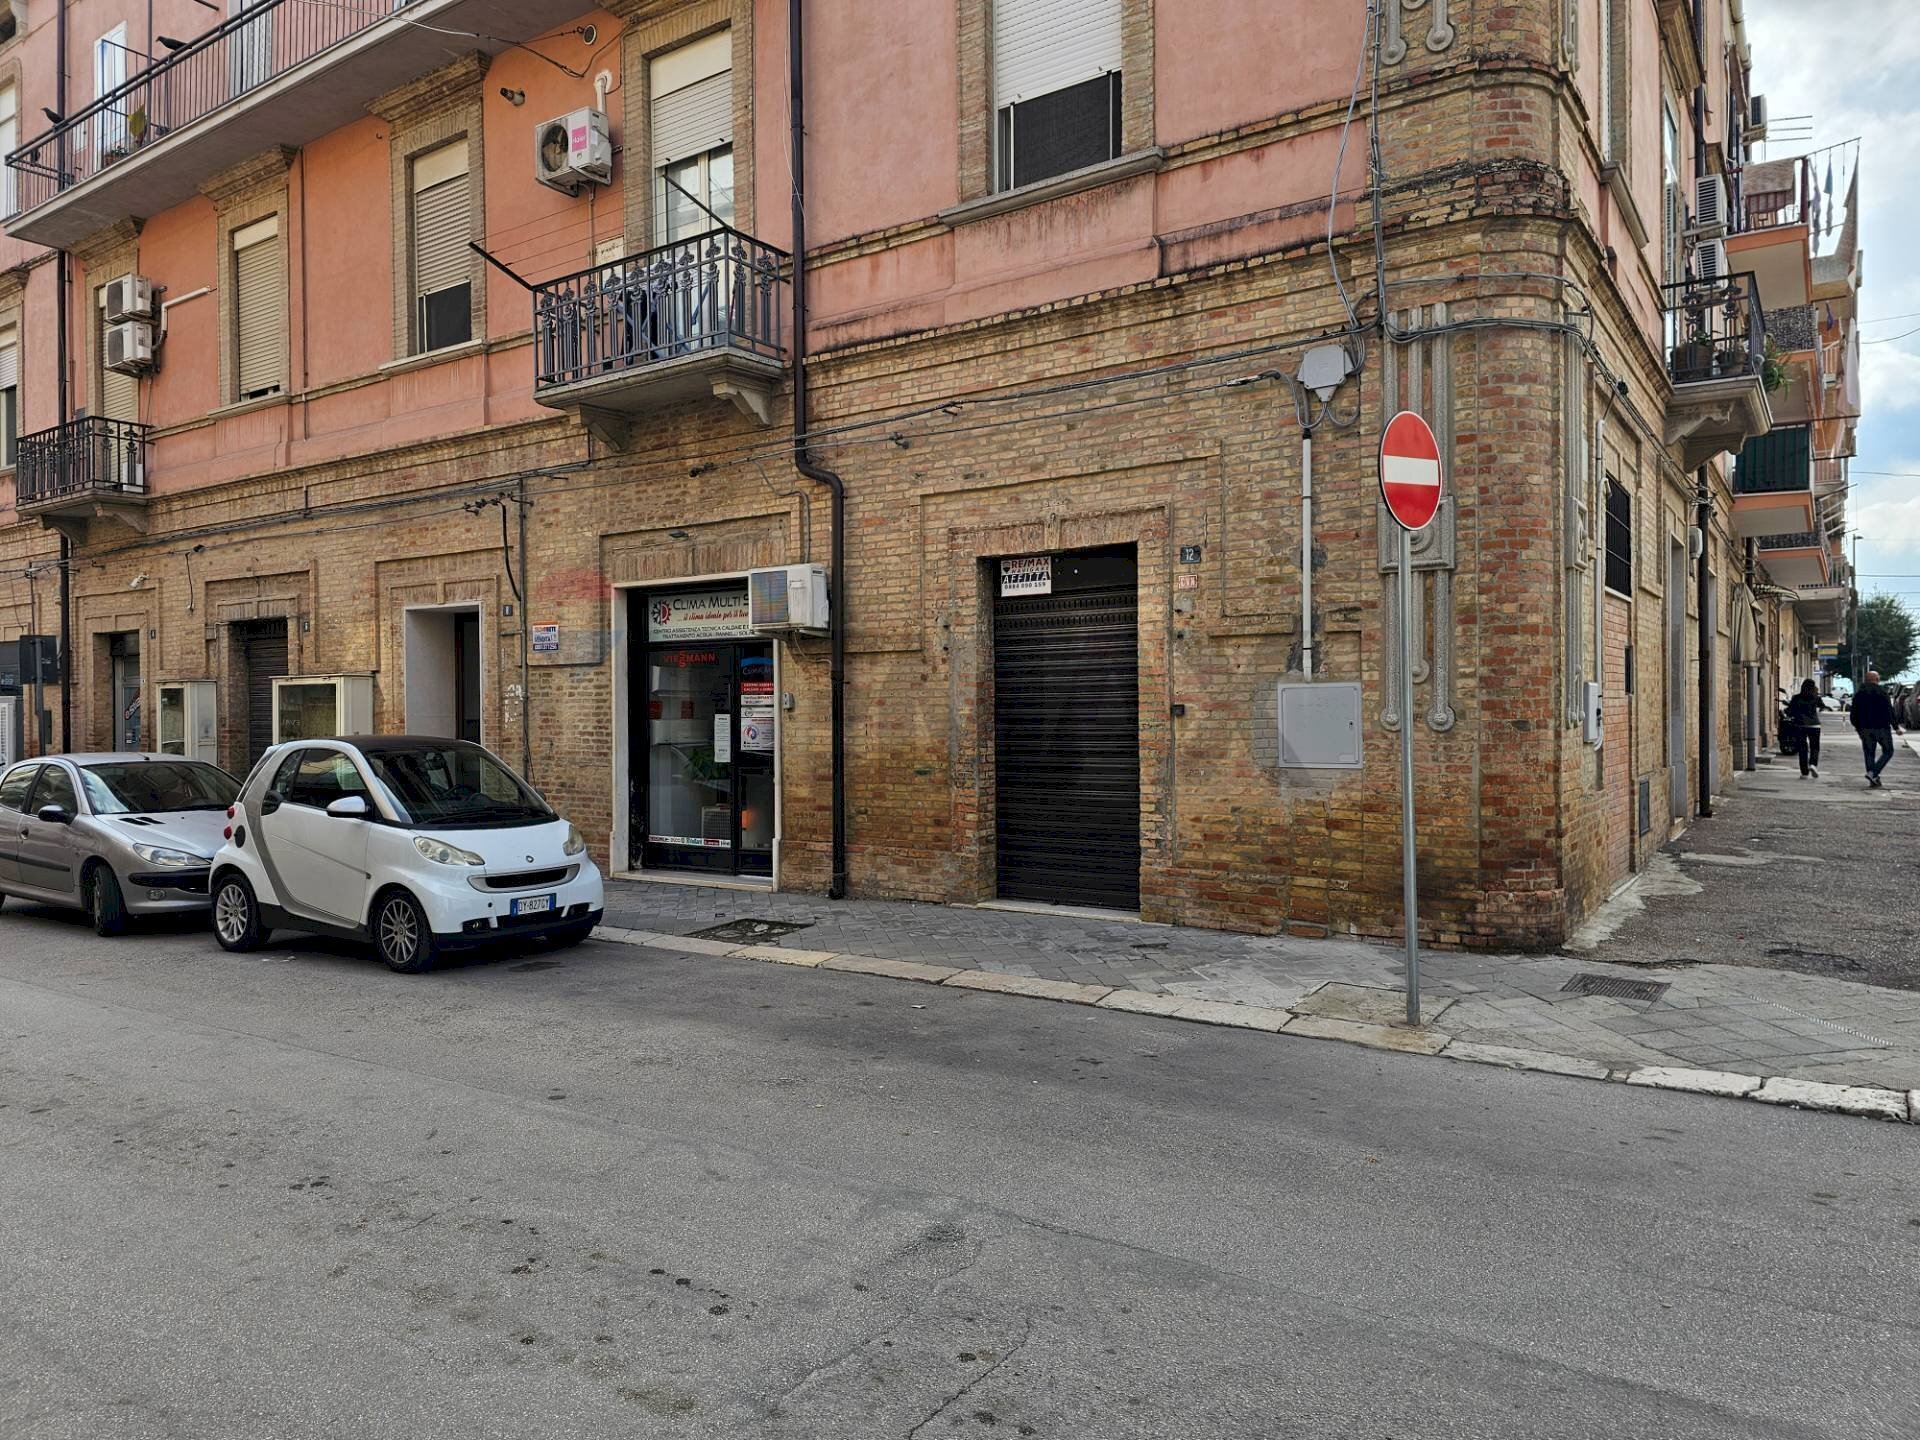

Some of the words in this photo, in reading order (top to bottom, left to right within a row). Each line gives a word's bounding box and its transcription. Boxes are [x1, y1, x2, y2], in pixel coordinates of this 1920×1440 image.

[1185, 548, 1194, 561] 12
[1011, 557, 1049, 569] RE/MAX
[1002, 571, 1048, 584] AFFITTA
[673, 598, 706, 611] CLIMA
[709, 595, 740, 608] MULTI
